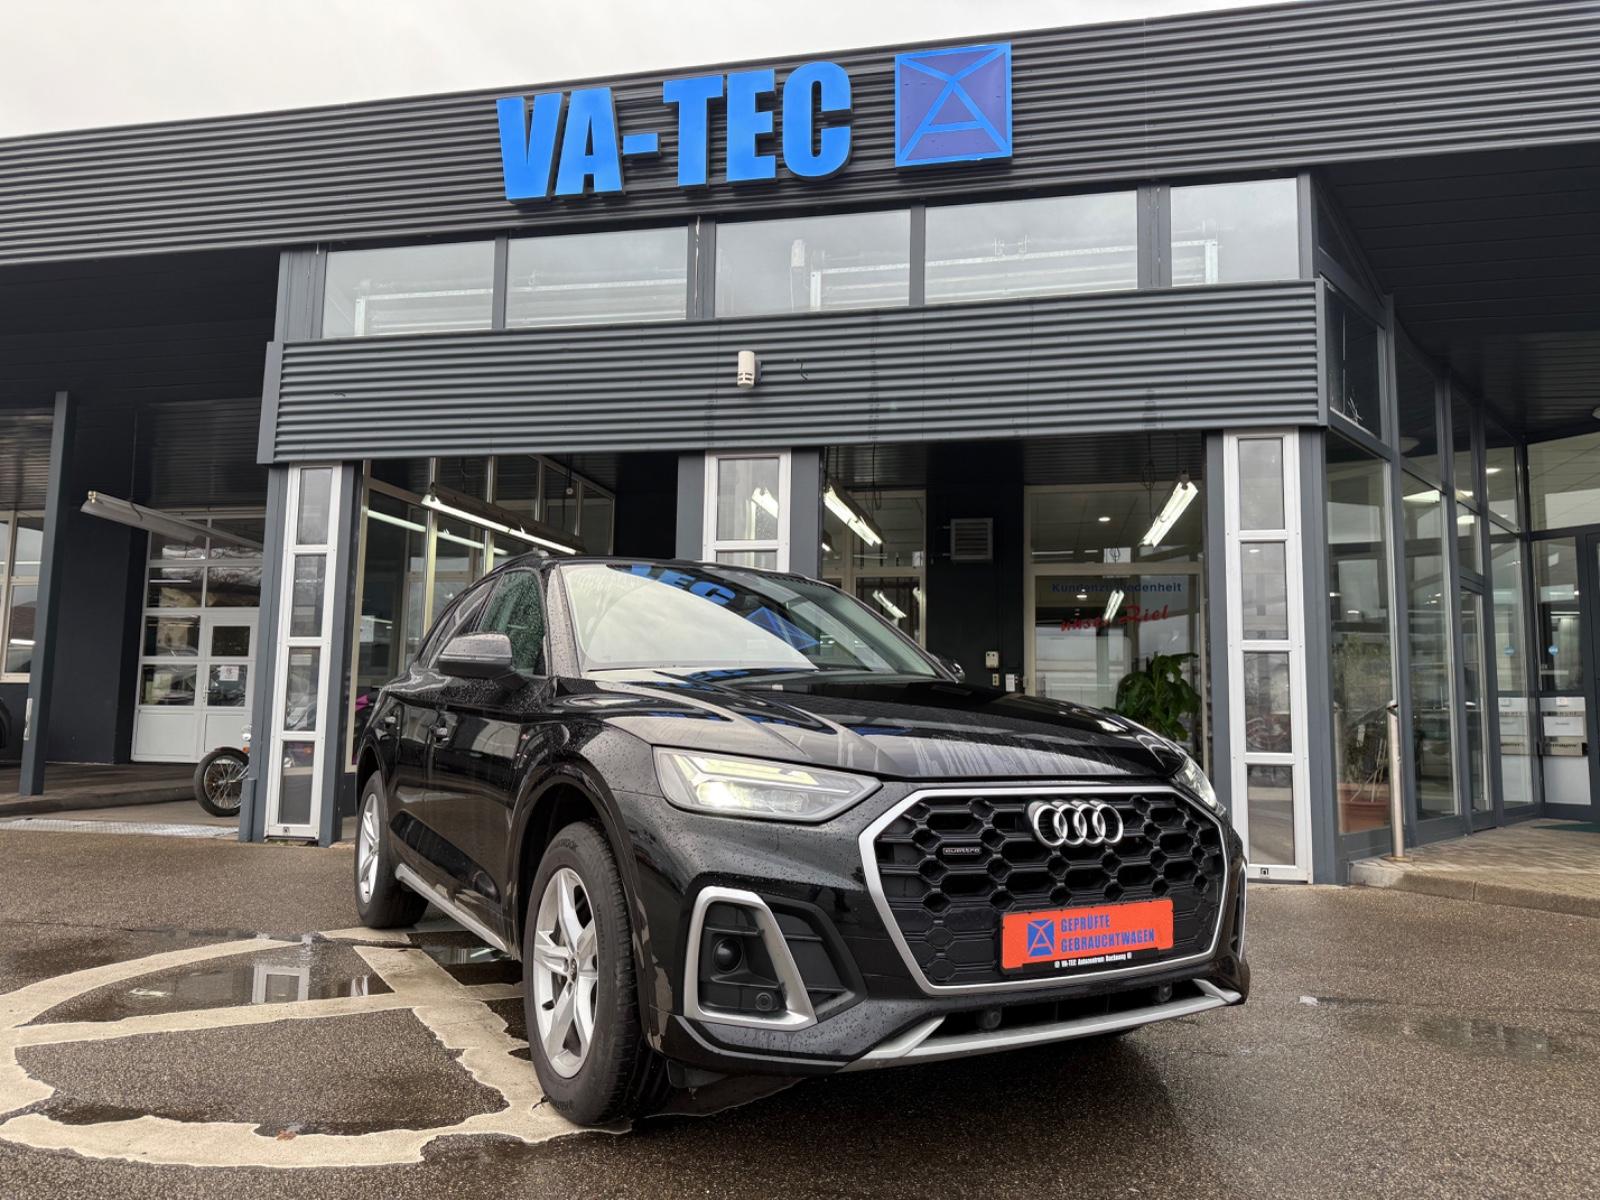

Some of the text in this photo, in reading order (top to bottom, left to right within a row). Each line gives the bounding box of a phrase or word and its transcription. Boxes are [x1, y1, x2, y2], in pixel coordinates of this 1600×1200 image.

[496, 61, 851, 200] VA-TEC
[1052, 582, 1182, 593] Kundenzuedenheit
[1119, 604, 1169, 625] Ziel
[1061, 913, 1110, 933] GEPRÜFTE
[1061, 928, 1155, 953] GEBRAUCHTWAGEN
